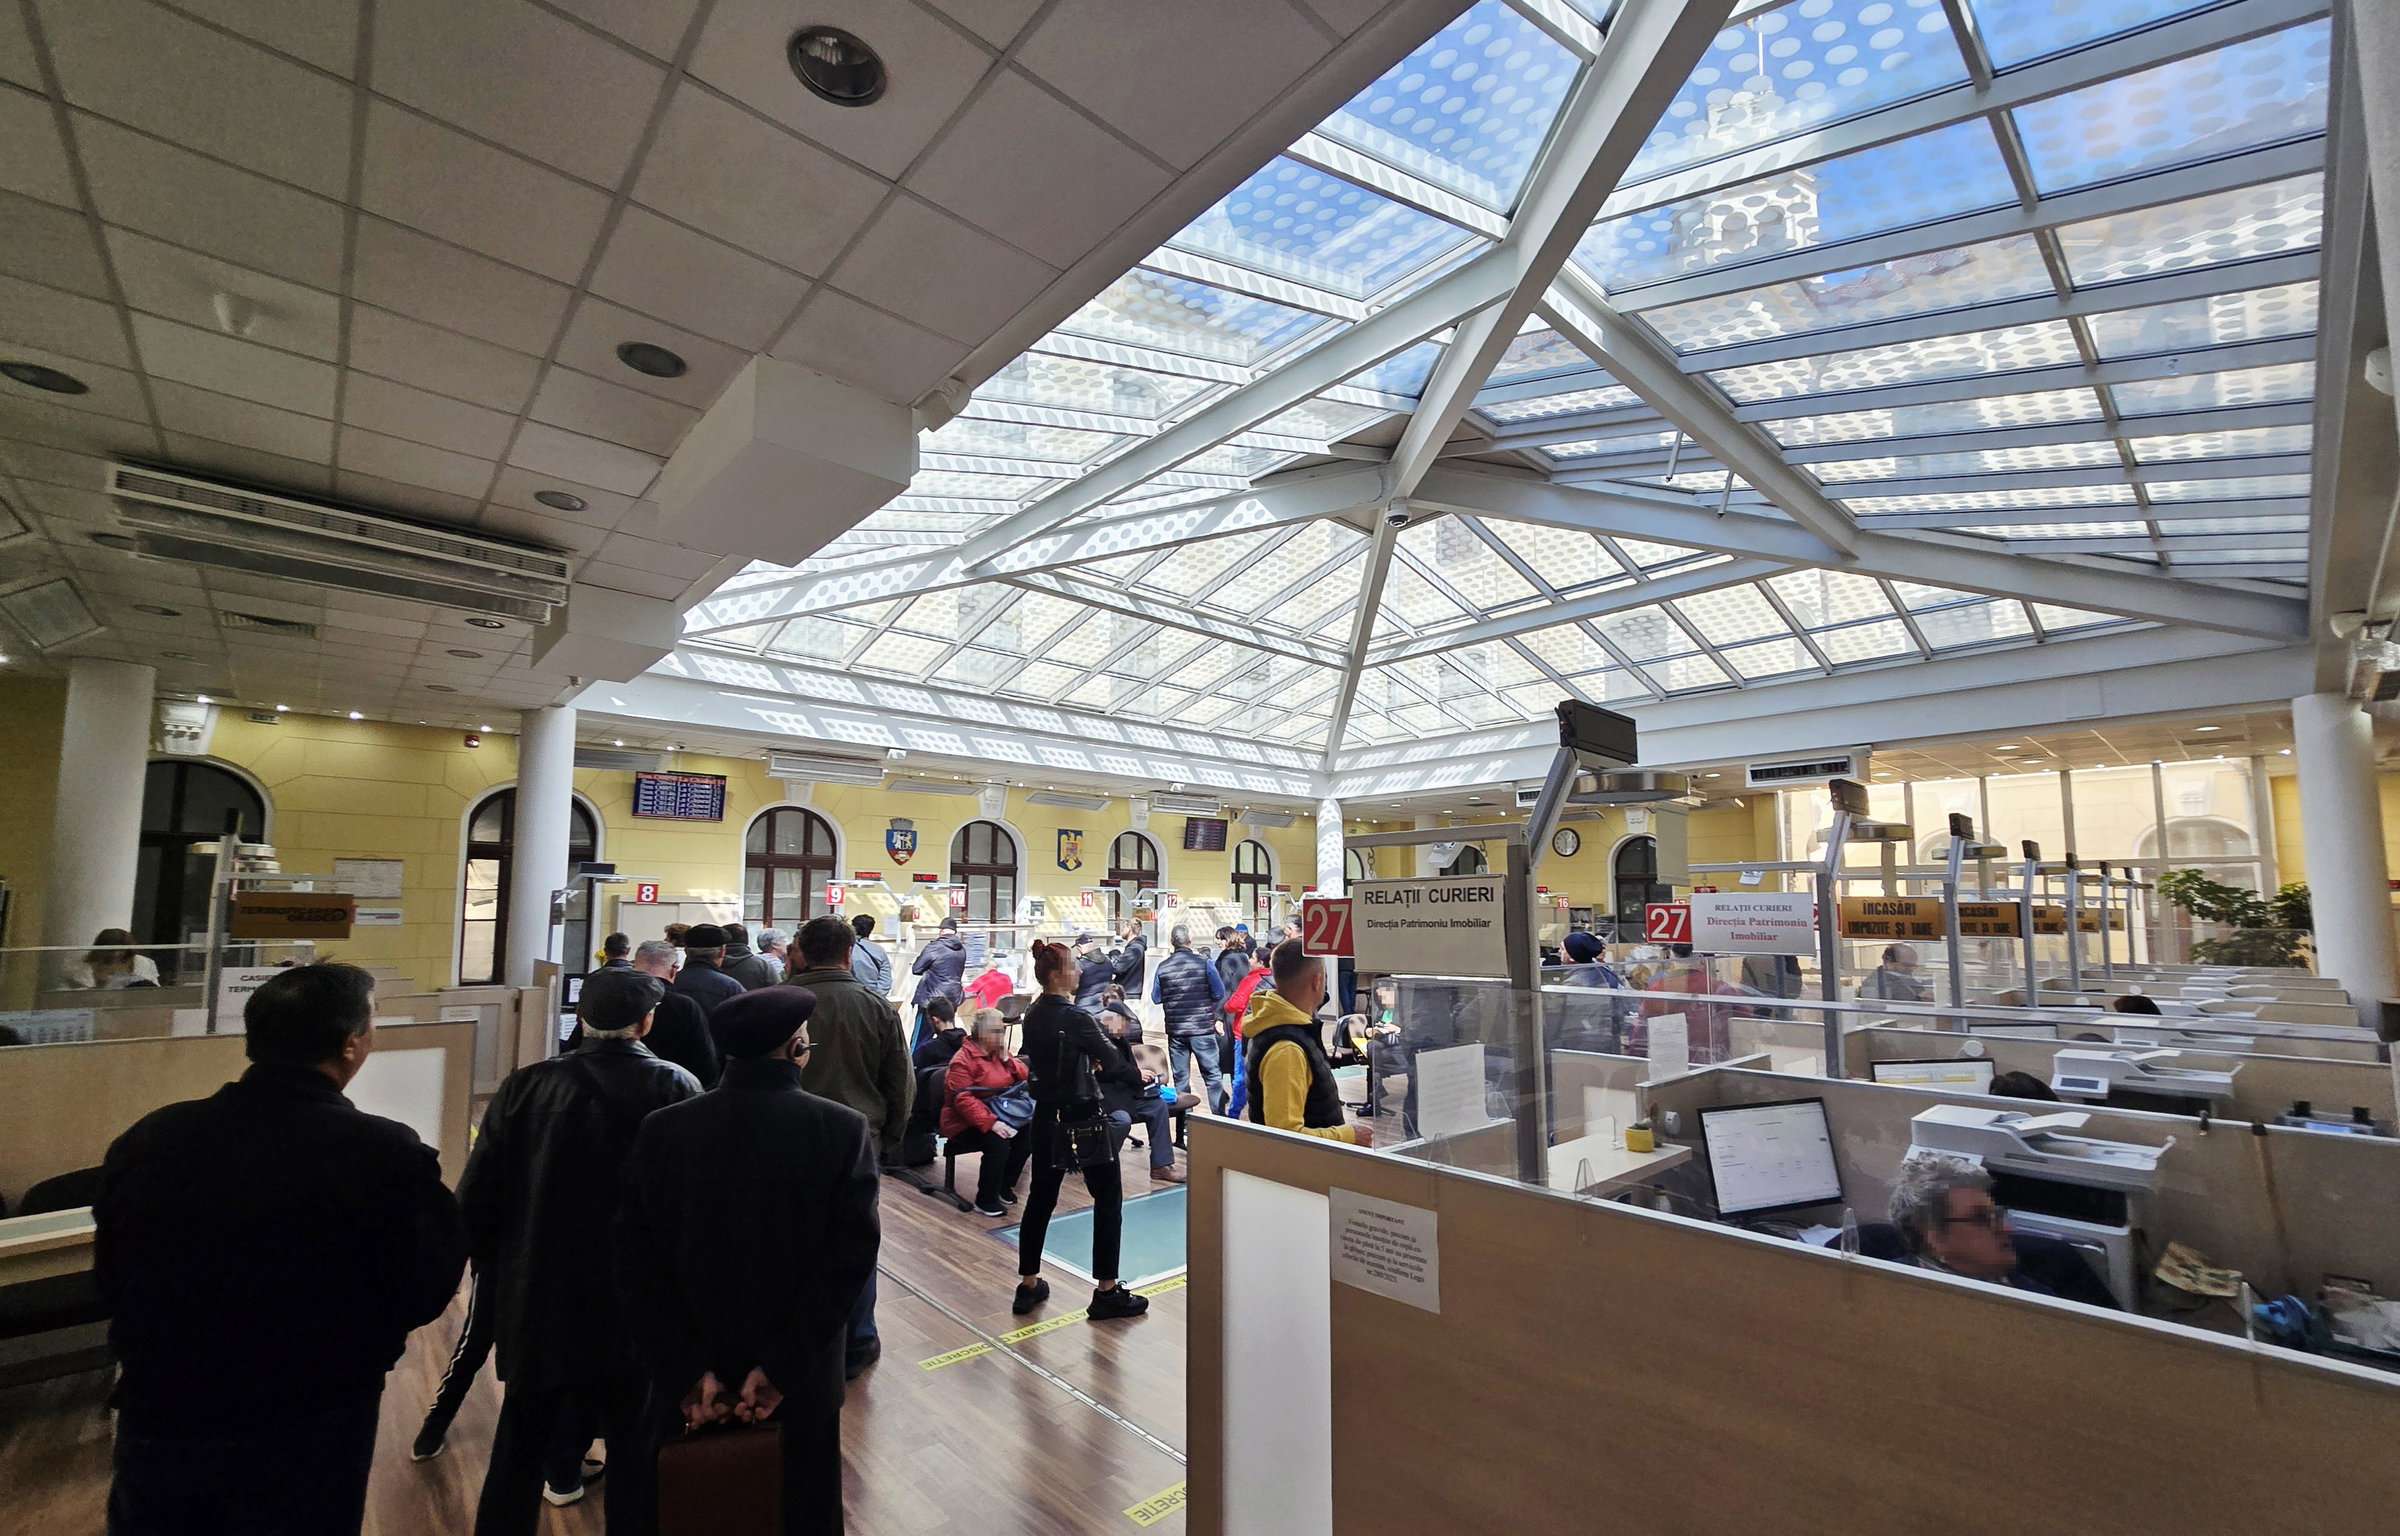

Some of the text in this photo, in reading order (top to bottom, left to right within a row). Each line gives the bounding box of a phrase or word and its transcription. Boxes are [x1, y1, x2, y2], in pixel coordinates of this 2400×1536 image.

[641, 886, 654, 902] 8
[831, 888, 842, 902] 9
[951, 890, 964, 905] 10
[1083, 893, 1093, 905] 11
[1365, 887, 1494, 908] RELAȚII CURIERI
[1168, 895, 1177, 907] 12
[1260, 896, 1268, 908] 13
[1558, 897, 1568, 908] 16
[1307, 904, 1349, 950] 27
[1400, 918, 1447, 928] Patrimoniu
[1450, 918, 1492, 928] Imobiliar
[1650, 908, 1687, 939] 27
[1748, 917, 1808, 927] Patrimoniu
[1731, 932, 1778, 941] Imobiliar
